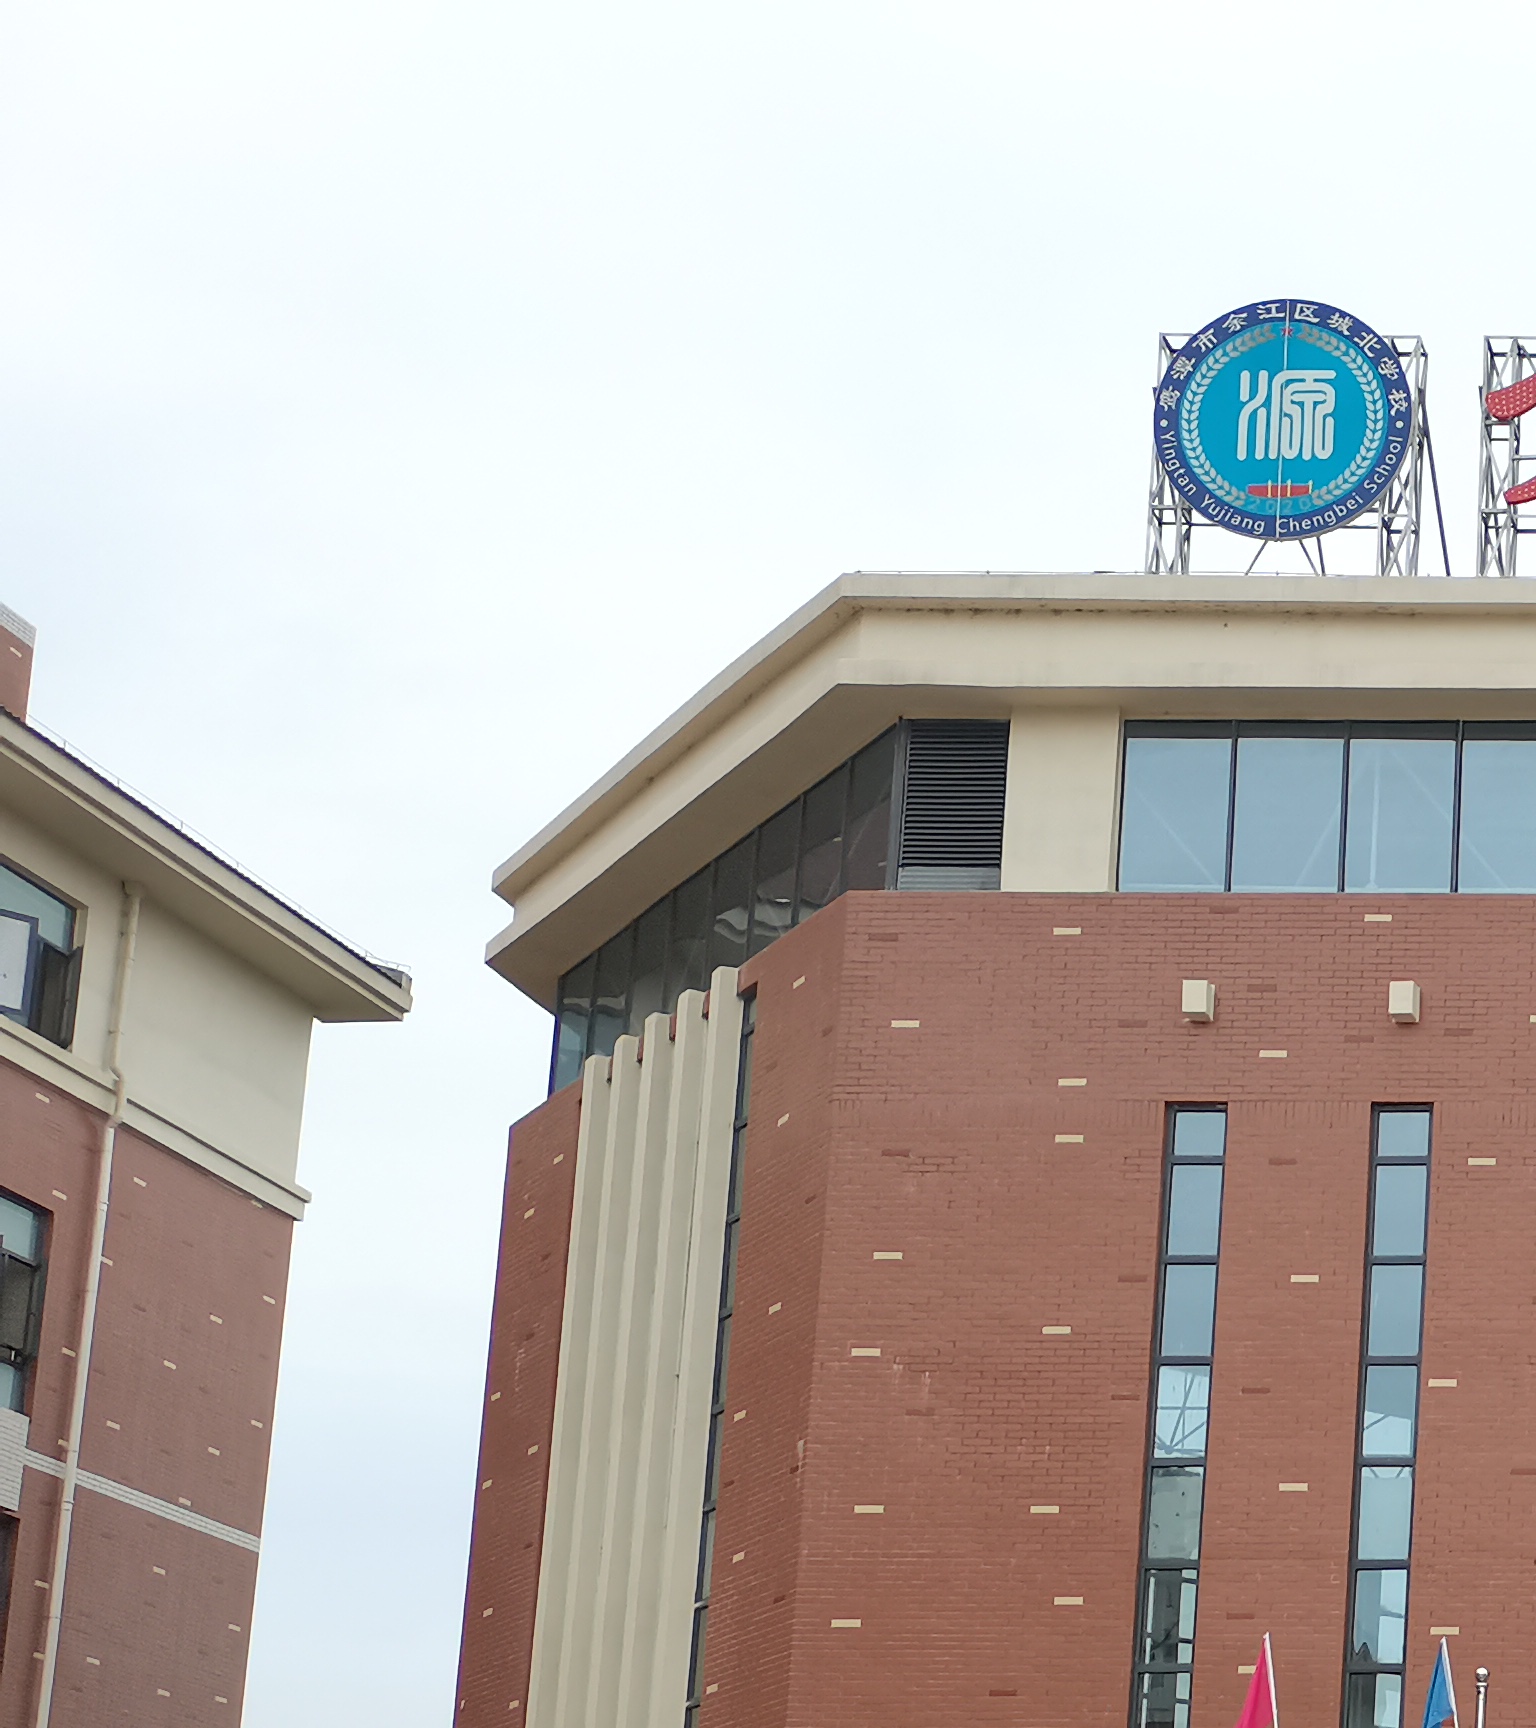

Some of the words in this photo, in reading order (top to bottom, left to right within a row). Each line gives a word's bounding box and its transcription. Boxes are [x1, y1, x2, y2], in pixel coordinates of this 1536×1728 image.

[1160, 430, 1197, 497] Yingtan
[1200, 494, 1266, 535] Yujiang
[1277, 492, 1364, 534] Chengbei
[1364, 435, 1404, 494] School
